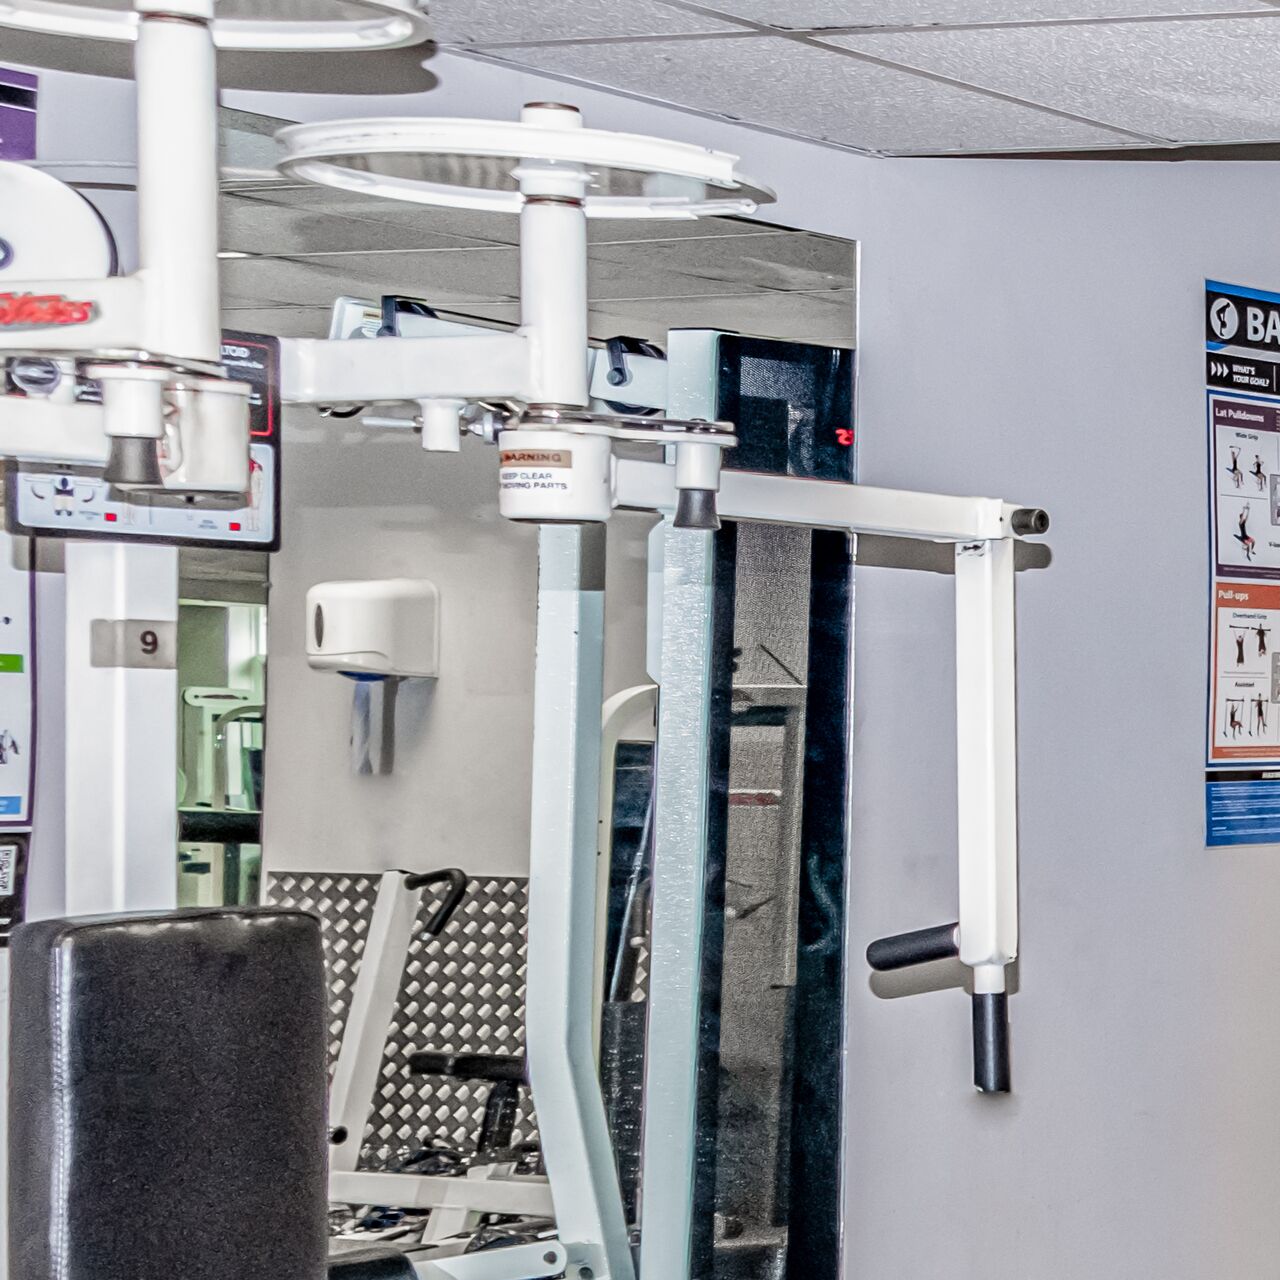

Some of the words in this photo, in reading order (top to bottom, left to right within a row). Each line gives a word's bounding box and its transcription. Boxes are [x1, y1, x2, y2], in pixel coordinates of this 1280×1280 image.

[1216, 408, 1226, 417] Lat
[1228, 409, 1264, 422] Pulldowns
[1218, 589, 1249, 601] Pull-ups
[140, 630, 158, 655] 9
